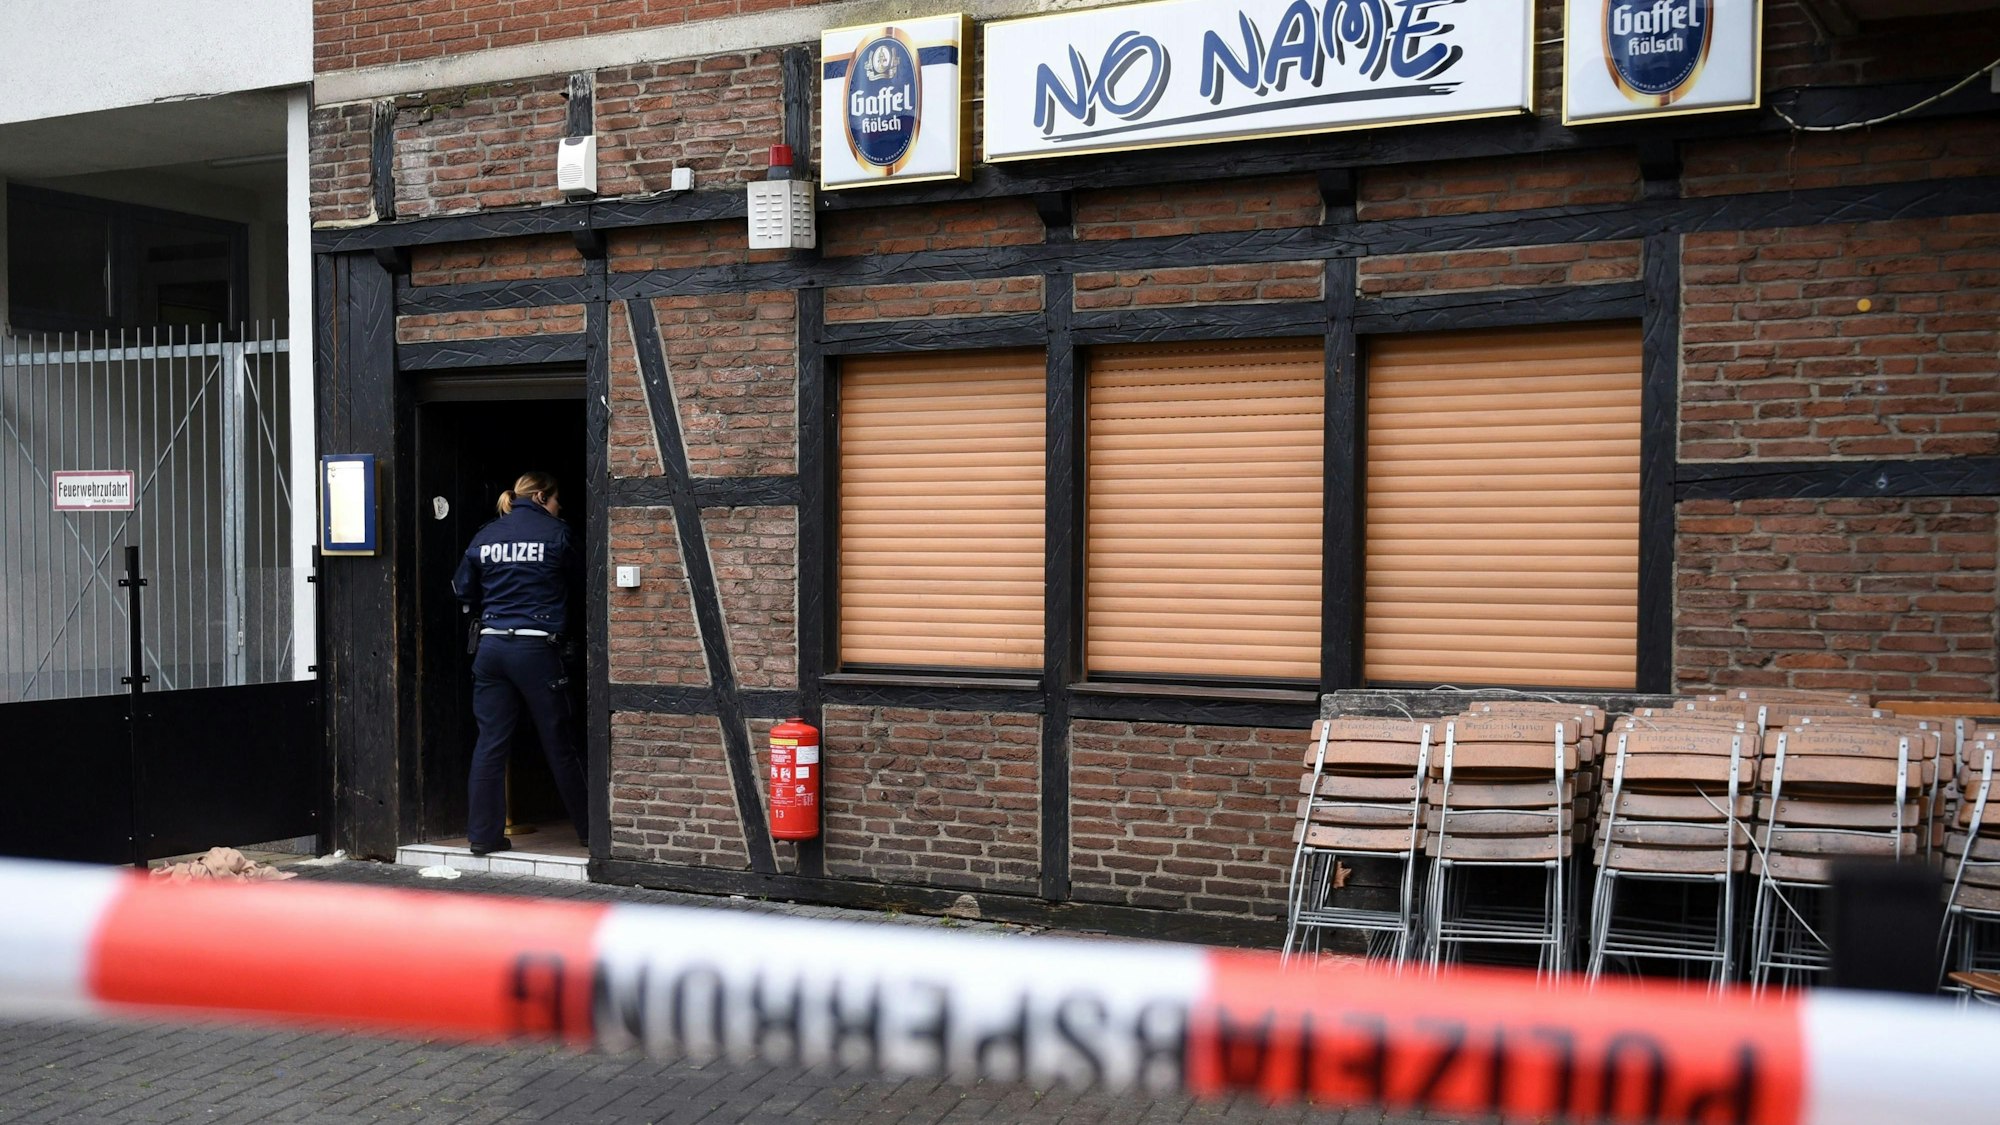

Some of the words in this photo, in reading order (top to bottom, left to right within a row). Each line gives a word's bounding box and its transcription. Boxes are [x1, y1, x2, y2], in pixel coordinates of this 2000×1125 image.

[1613, 0, 1701, 36] Gaffel
[1628, 33, 1684, 56] Kölsch
[1033, 31, 1171, 134] NO
[1200, 0, 1463, 105] NAME
[851, 84, 913, 116] Gaffel
[862, 115, 901, 134] Kölsch
[58, 482, 128, 497] Feuerwehrzufahrt
[480, 542, 545, 563] POLIZEI
[775, 809, 784, 819] 13
